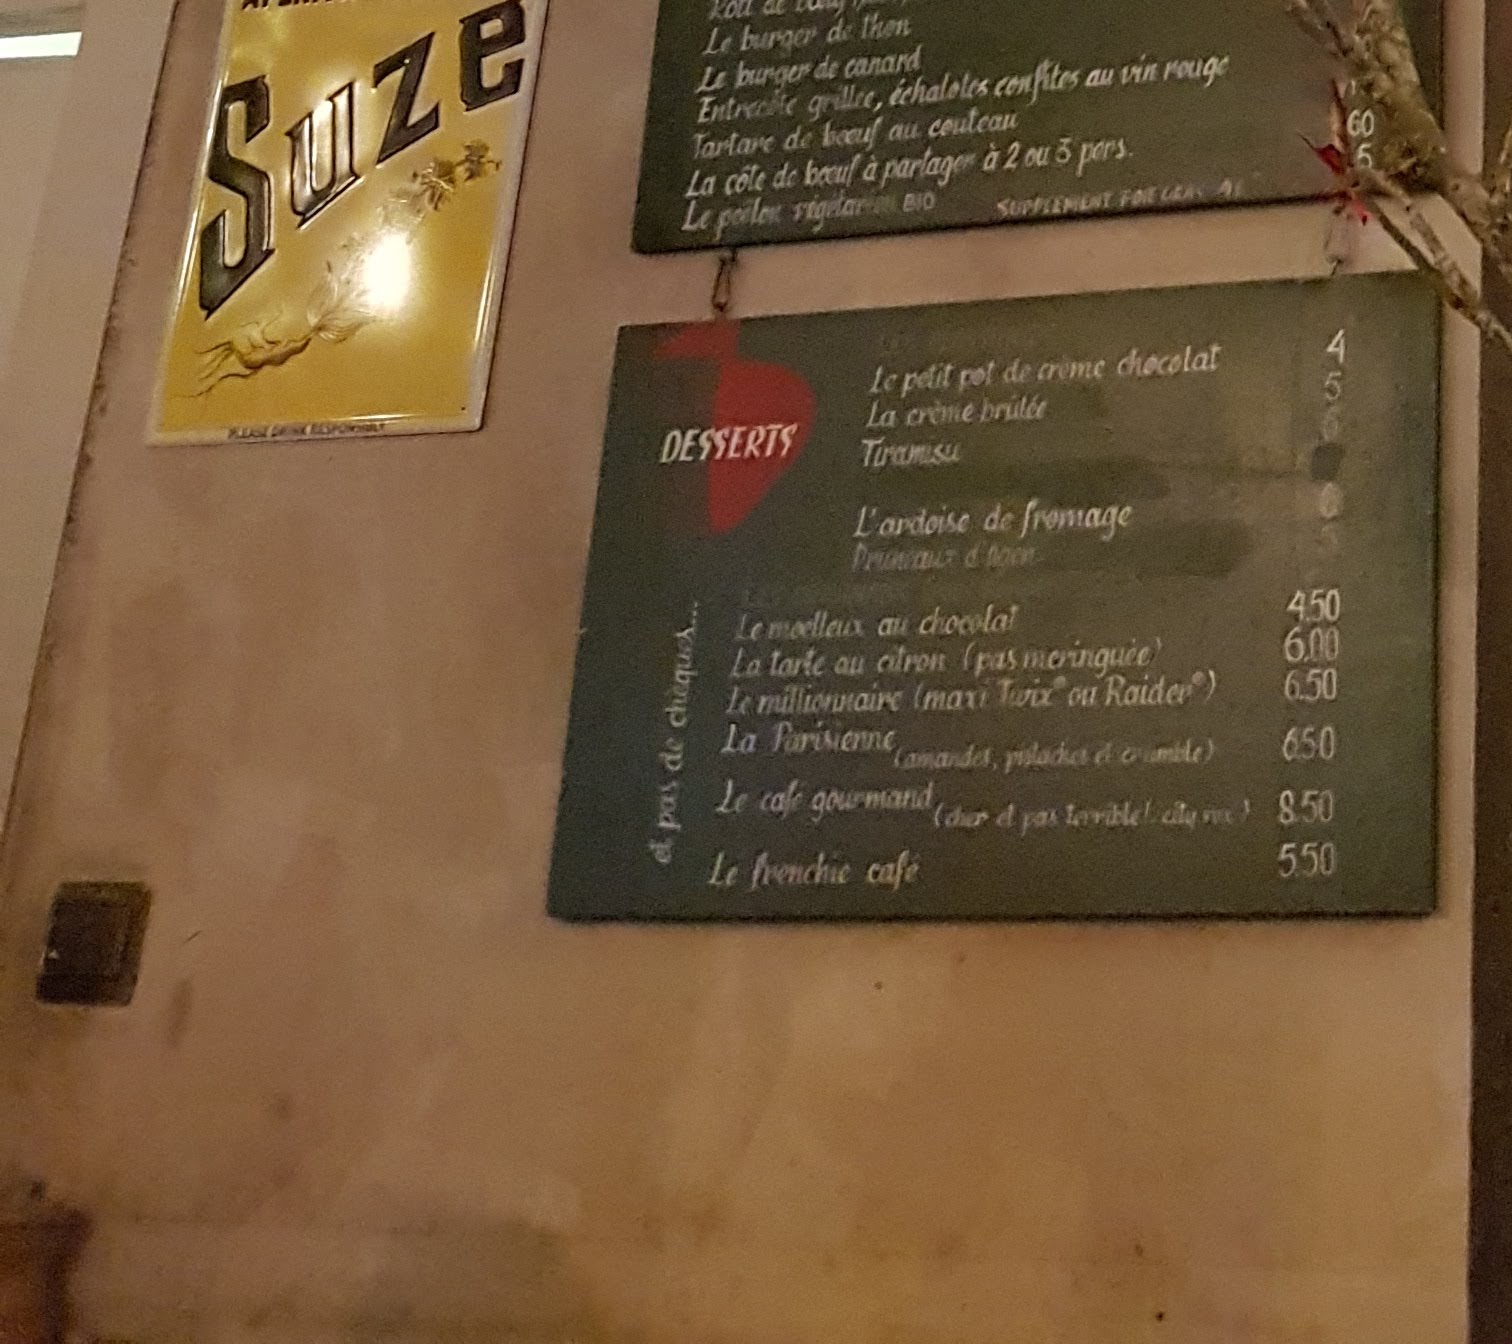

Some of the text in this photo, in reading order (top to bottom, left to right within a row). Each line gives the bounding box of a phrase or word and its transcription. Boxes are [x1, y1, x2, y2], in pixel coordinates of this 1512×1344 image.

[702, 26, 732, 56] Le
[740, 24, 818, 57] burger
[696, 45, 924, 94] Le burger de canard
[1084, 67, 1115, 89] au
[1119, 53, 1158, 86] vin
[1162, 55, 1231, 89] rouge
[691, 132, 776, 162] Tartare
[782, 124, 811, 152] de
[888, 120, 920, 142] au
[927, 106, 1020, 140] couteau
[685, 170, 717, 199] La
[772, 161, 798, 190] de
[862, 153, 879, 183] à
[982, 144, 997, 172] à
[1003, 140, 1022, 169] 2
[1024, 148, 1051, 169] ou
[868, 364, 898, 395] Le
[899, 361, 956, 400] petit
[1003, 357, 1031, 385] de
[1116, 342, 1223, 380] chocolat
[1326, 328, 1346, 363] 4
[866, 399, 897, 429] La
[659, 422, 800, 464] DESSERTS
[983, 501, 1013, 533] de
[1020, 496, 1136, 542] fromage
[877, 614, 908, 637] au
[919, 604, 1020, 636] chocolat
[729, 647, 762, 678] La
[769, 646, 826, 678] tarte
[834, 654, 865, 676] au
[876, 644, 947, 674] citron
[725, 685, 755, 715] Le
[1067, 683, 1099, 706] ou
[719, 722, 758, 754] La
[715, 778, 749, 814] Le
[811, 780, 935, 823] gourmand
[707, 851, 739, 886] Le
